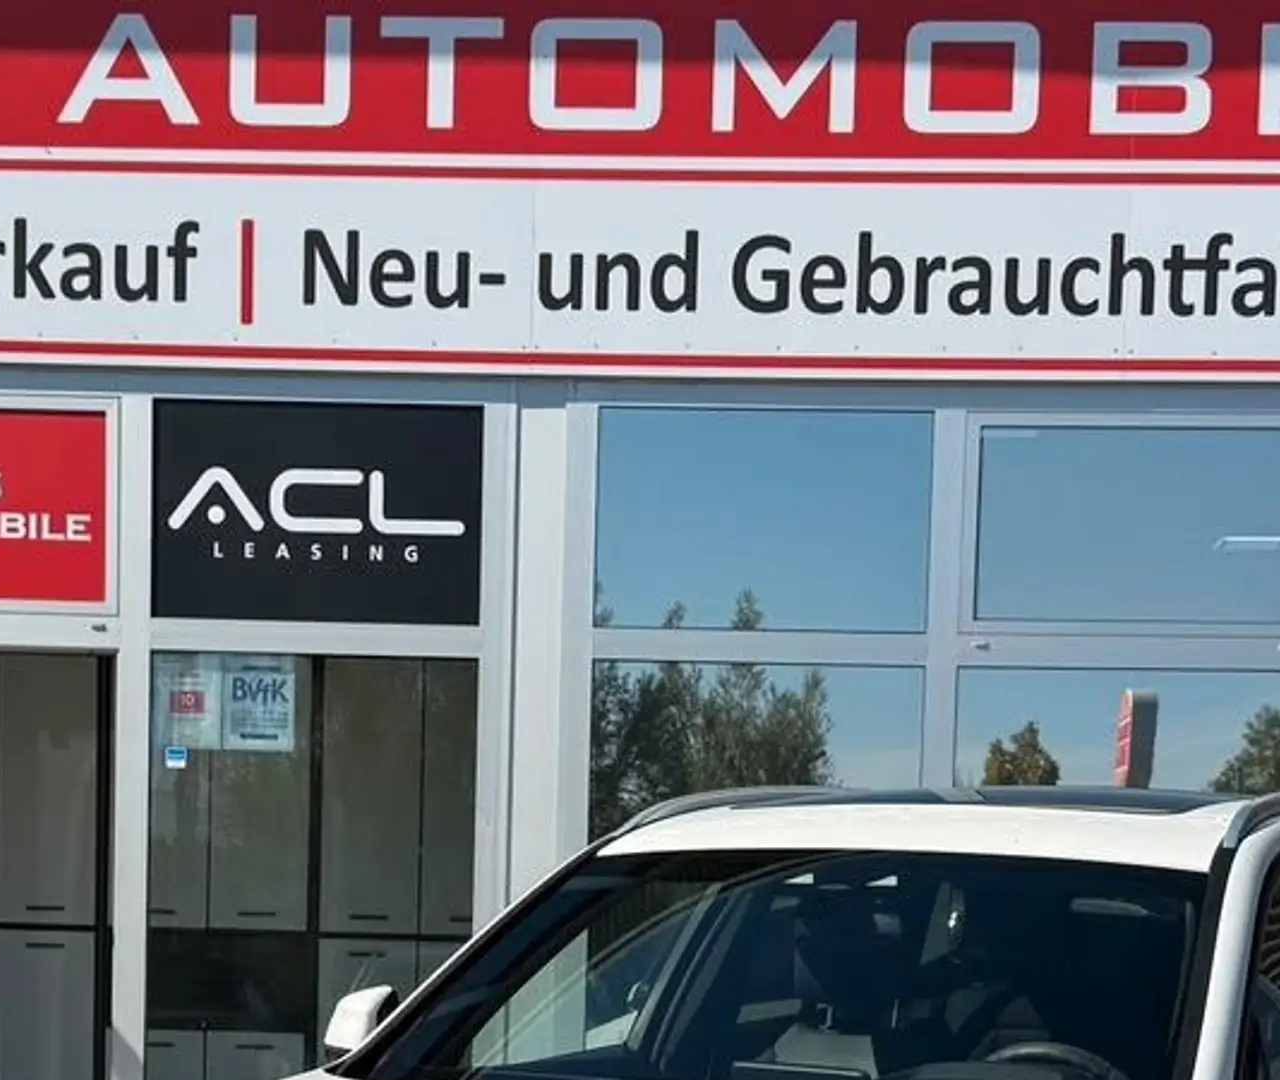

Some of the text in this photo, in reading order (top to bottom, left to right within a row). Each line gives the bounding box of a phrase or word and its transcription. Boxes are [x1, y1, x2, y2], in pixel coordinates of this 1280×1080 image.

[302, 228, 507, 309] Neu-
[538, 230, 700, 312] und
[169, 465, 466, 537] ACL
[212, 541, 420, 563] LEASING
